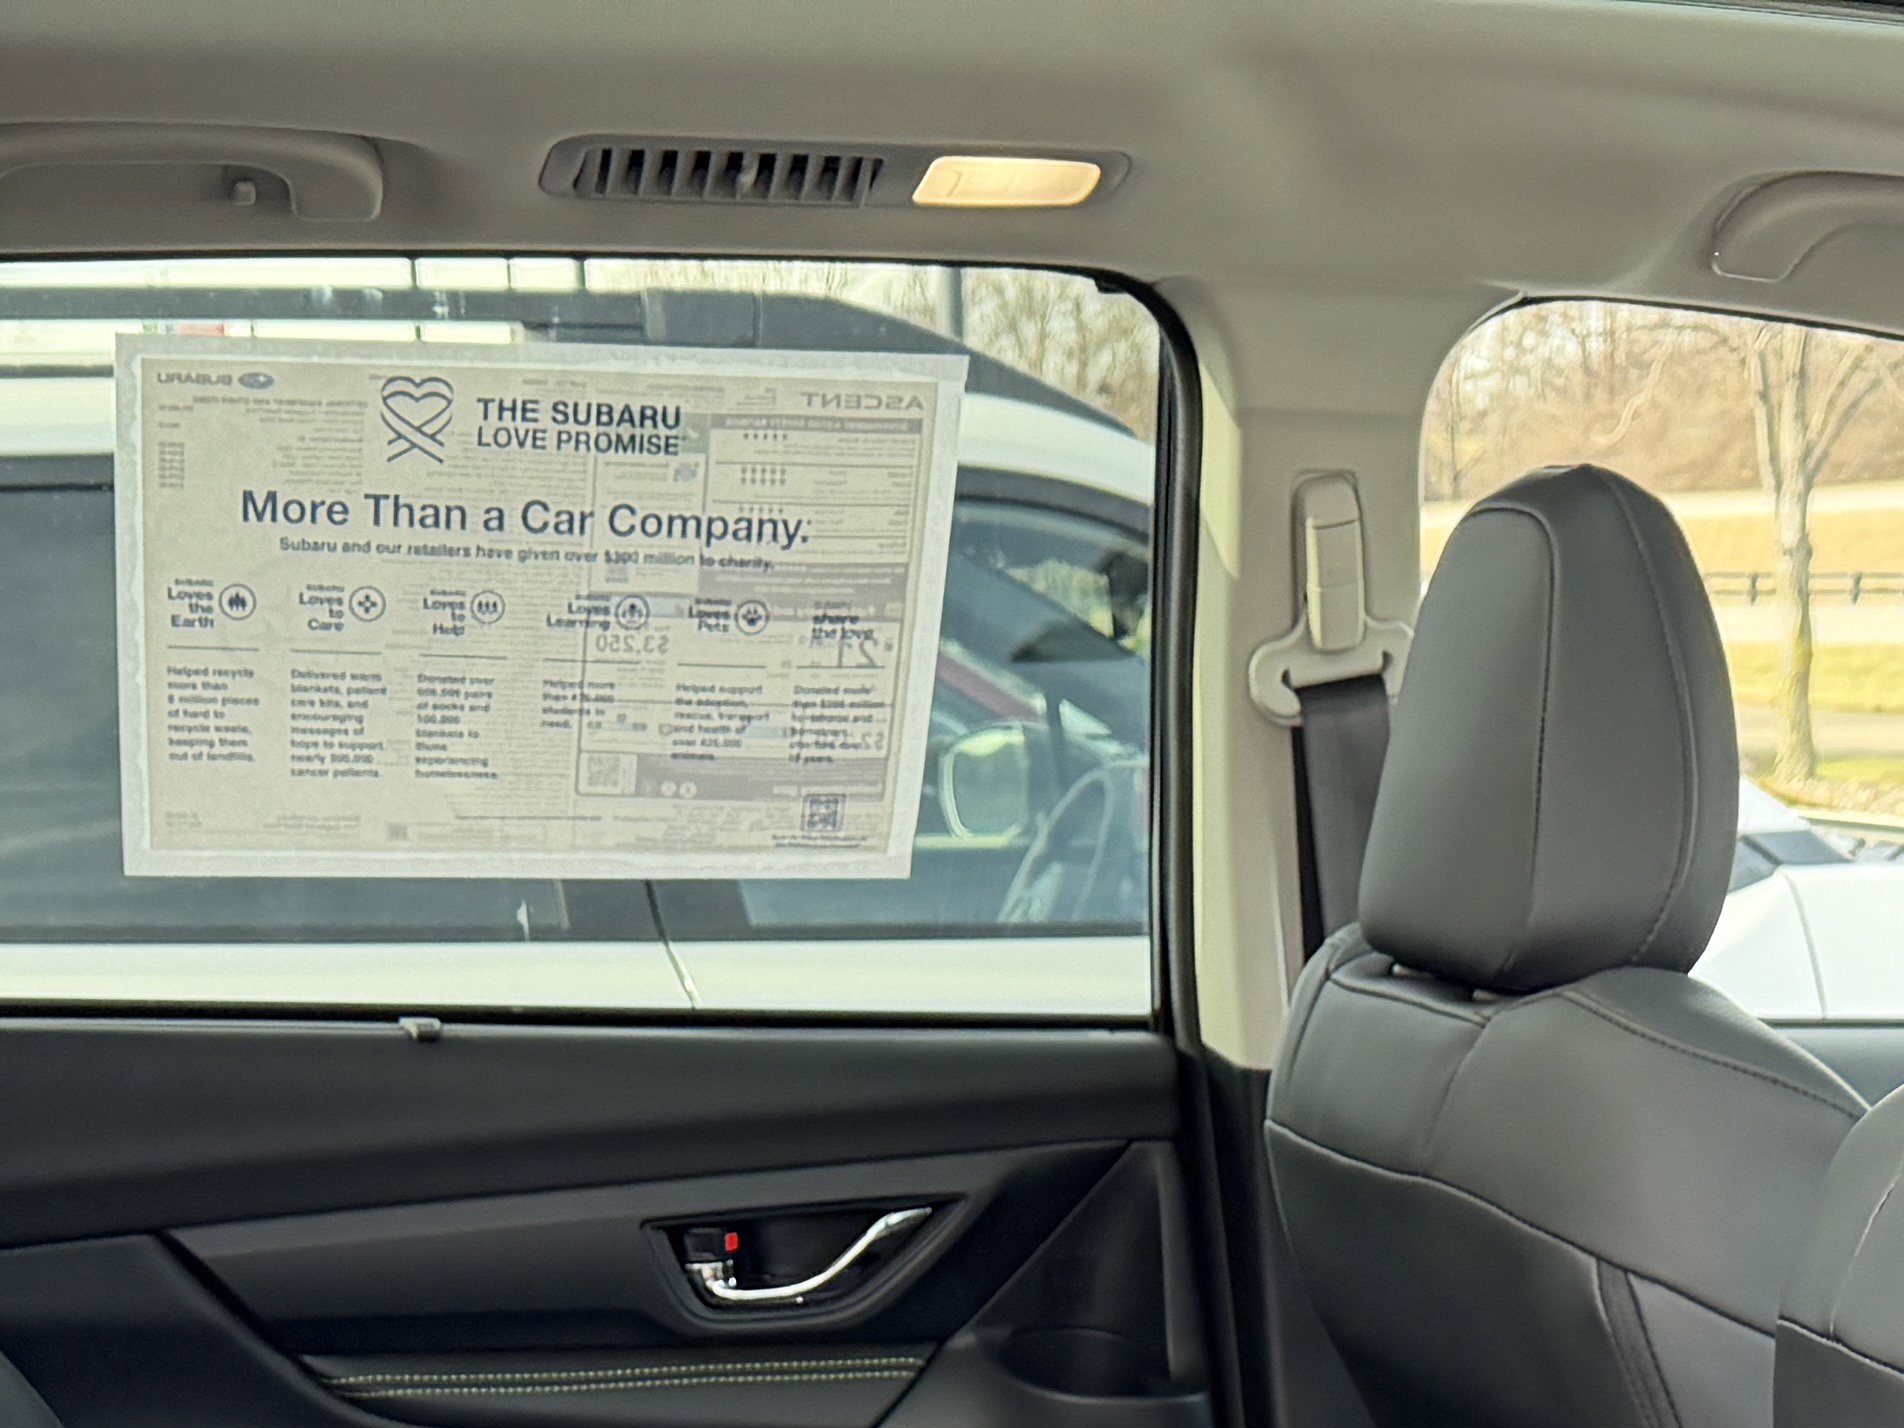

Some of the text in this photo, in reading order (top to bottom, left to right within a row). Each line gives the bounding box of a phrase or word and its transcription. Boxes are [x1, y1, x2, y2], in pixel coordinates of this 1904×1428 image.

[477, 398, 681, 430] THE SUBARU
[477, 426, 680, 456] LOVE PROMISE
[242, 490, 809, 550] More Than a Car Company.
[279, 536, 337, 552] Subaru
[342, 540, 371, 554] and
[376, 543, 401, 555] our
[407, 543, 471, 558] retailers
[476, 545, 513, 560] have
[518, 548, 560, 563] given
[564, 550, 596, 563] over
[643, 551, 695, 566] million
[167, 587, 214, 601] Loves
[299, 592, 344, 606] Loves
[188, 602, 214, 614] the
[423, 598, 466, 611] Loves
[568, 602, 610, 615] Loves
[329, 607, 344, 619] to
[451, 611, 465, 622] to
[689, 605, 731, 619] Loves
[171, 614, 214, 628] Earth
[308, 618, 344, 631] Care
[547, 614, 610, 631] Learning
[698, 621, 729, 633] Pets
[433, 623, 465, 636] Help
